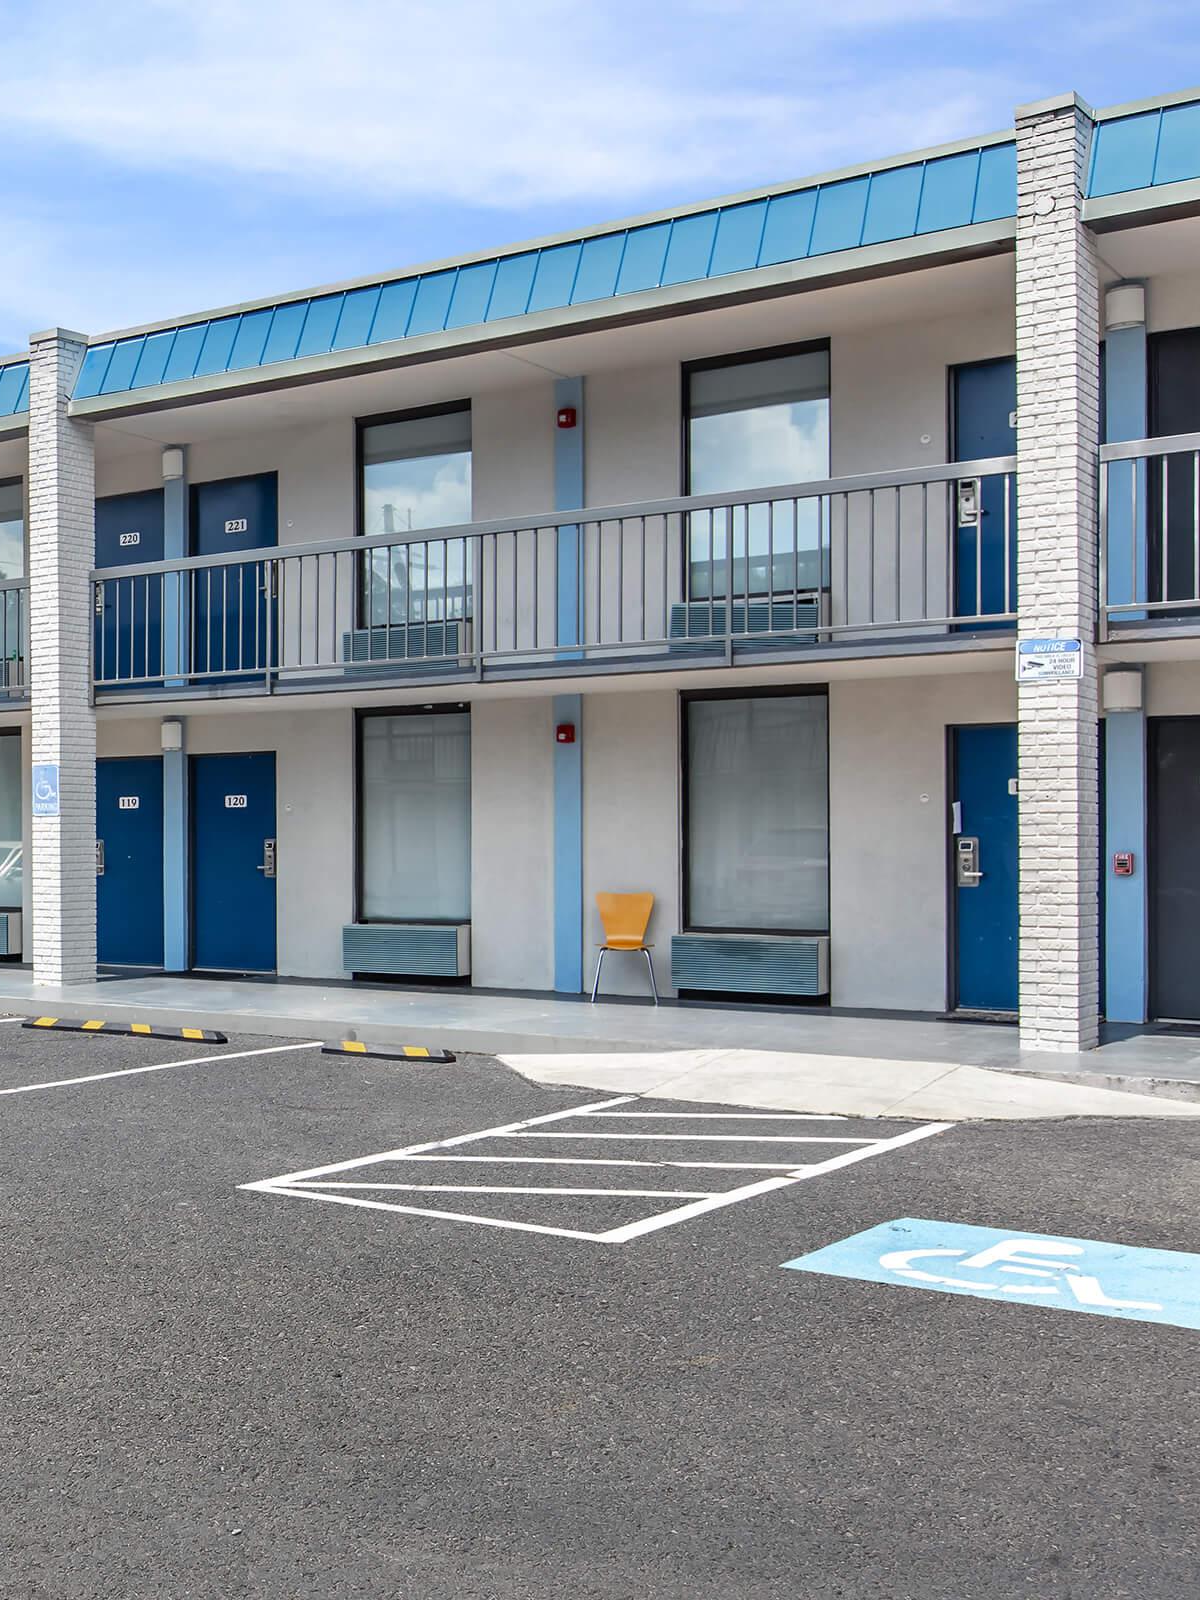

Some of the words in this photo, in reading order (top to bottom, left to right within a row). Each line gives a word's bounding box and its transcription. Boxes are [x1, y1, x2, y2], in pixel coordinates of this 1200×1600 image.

[228, 520, 245, 531] 221
[121, 534, 138, 544] 220
[1033, 641, 1067, 653] NOTICE
[121, 798, 137, 807] 119
[228, 797, 245, 806] 120
